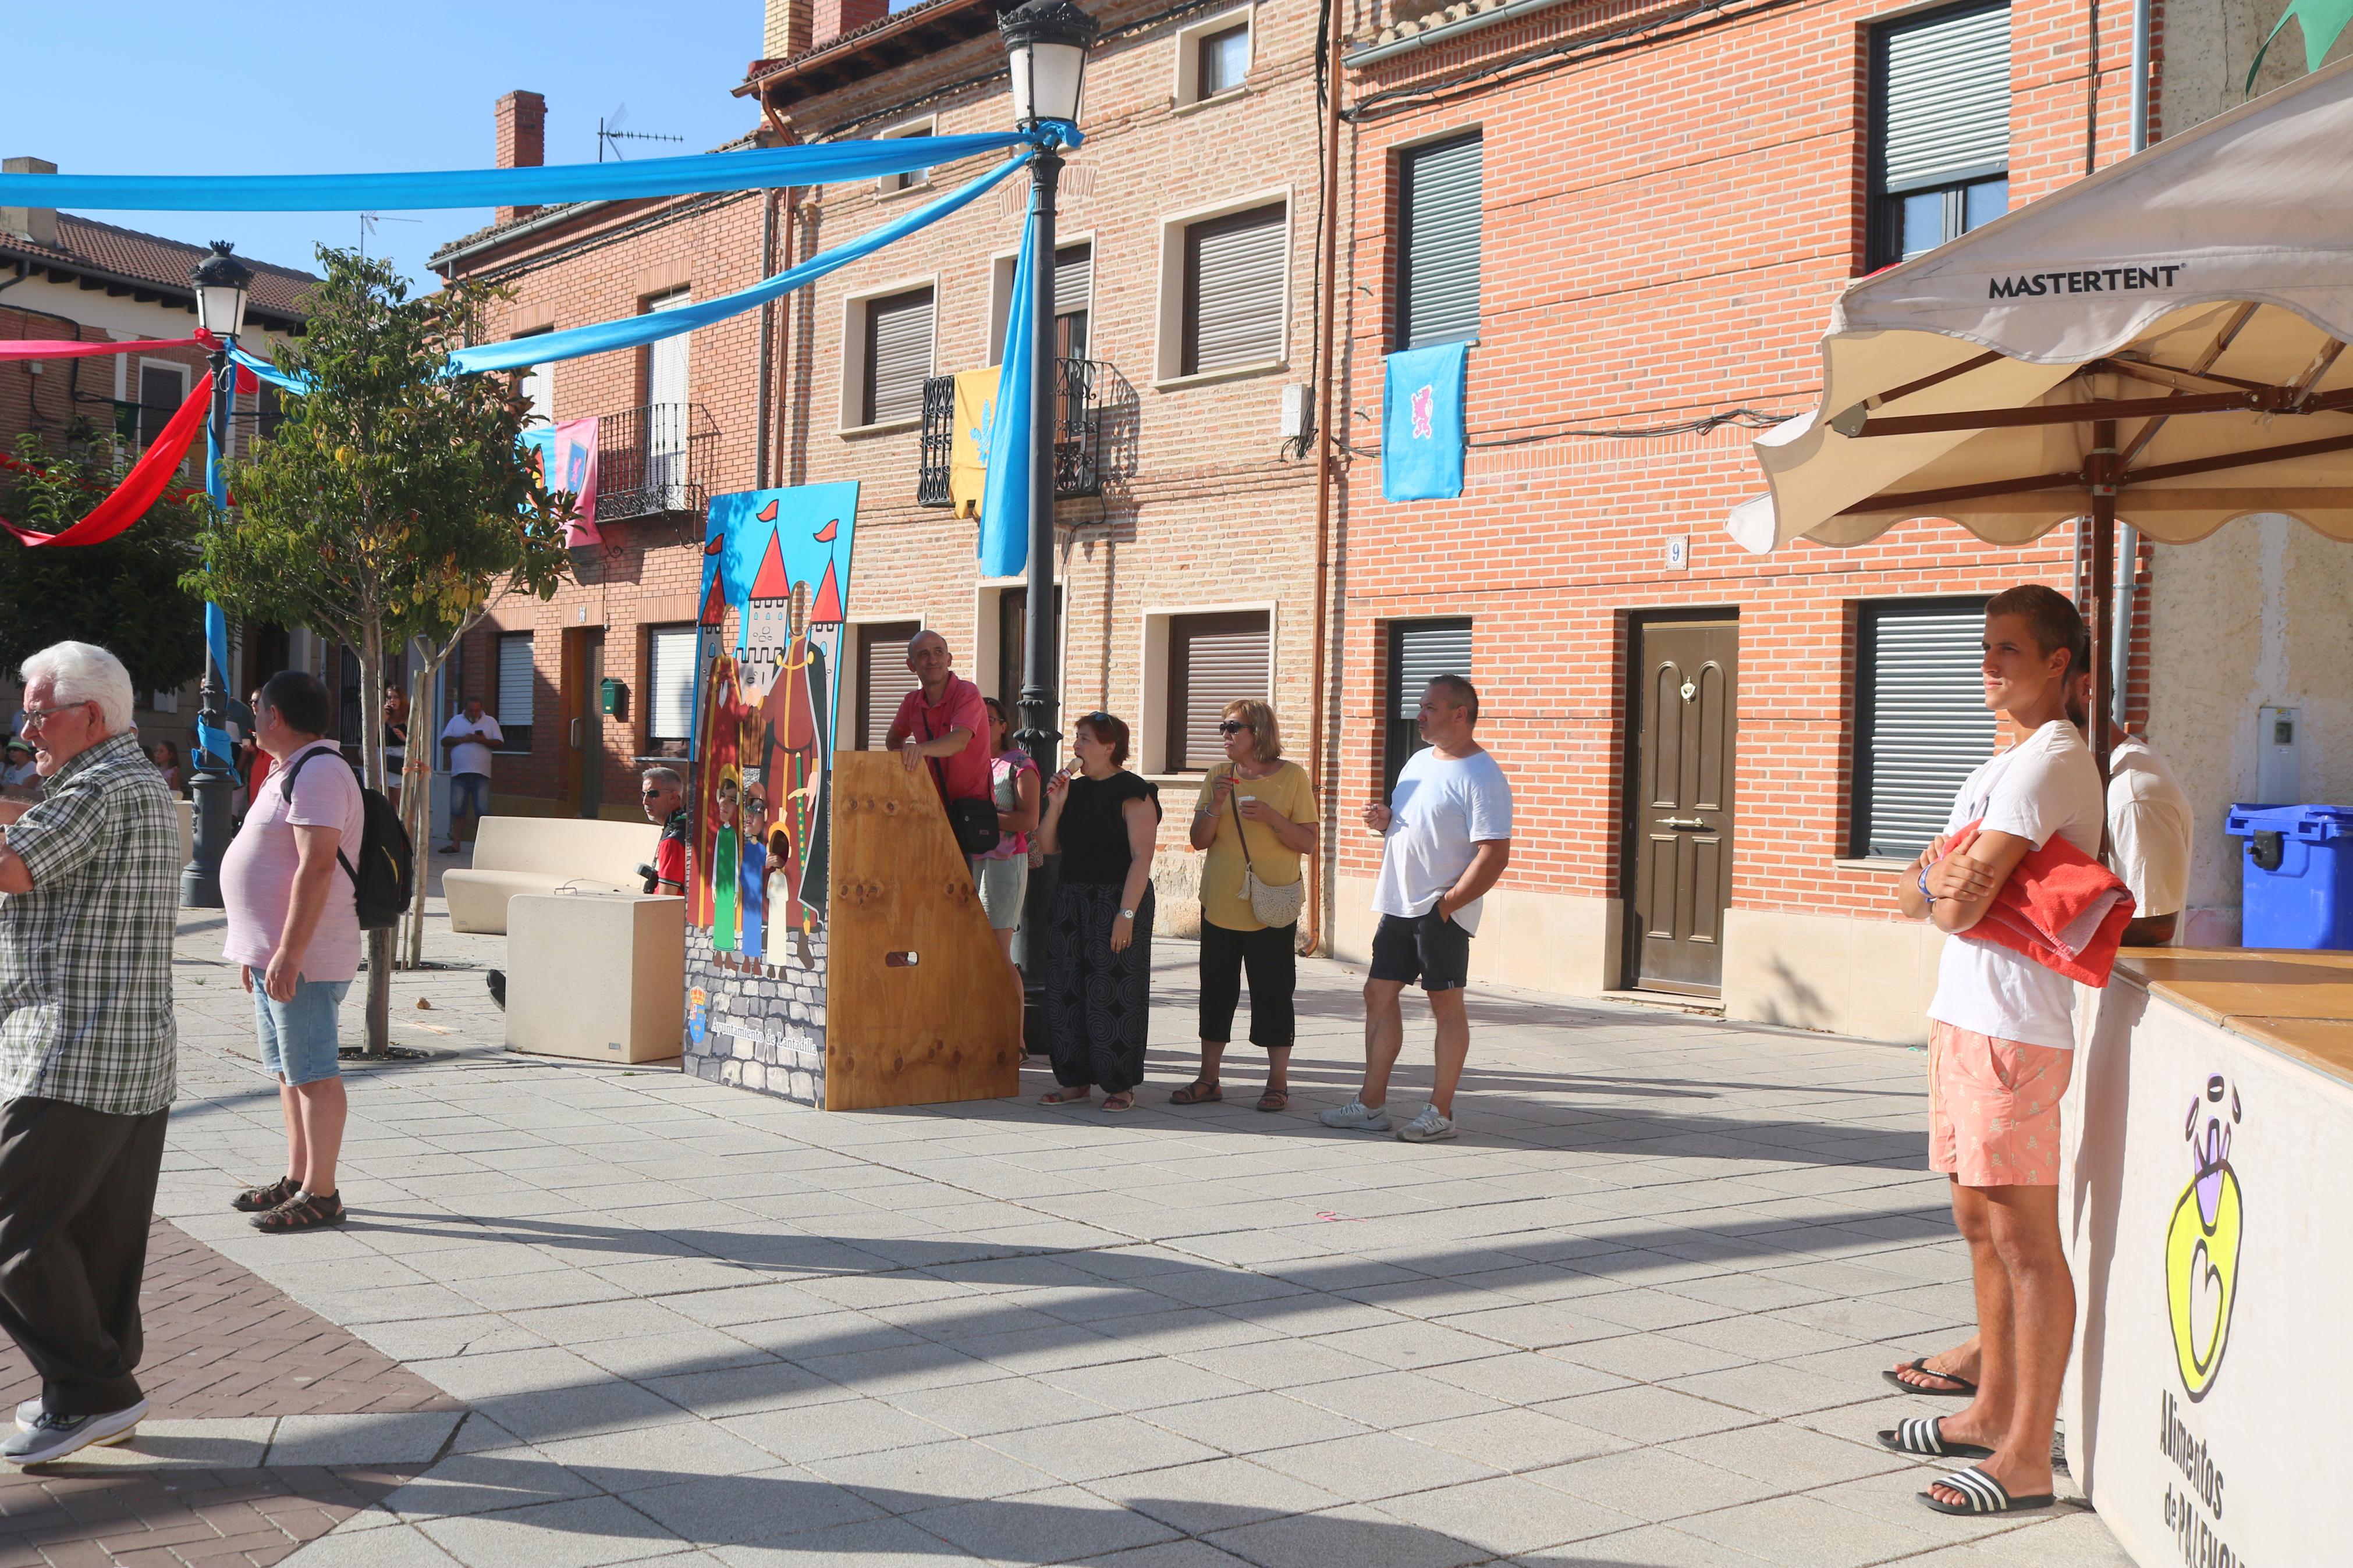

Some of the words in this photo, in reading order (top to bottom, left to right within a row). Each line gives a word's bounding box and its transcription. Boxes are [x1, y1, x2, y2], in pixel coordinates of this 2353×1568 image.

[1989, 265, 2180, 299] MASTERTENT
[1673, 543, 1679, 561] 9
[711, 1017, 765, 1043] Ayuntamiento
[765, 1029, 776, 1046] de
[776, 1032, 818, 1055] Lantadilla
[2160, 1388, 2224, 1520] Alimentos
[2164, 1481, 2176, 1532] de
